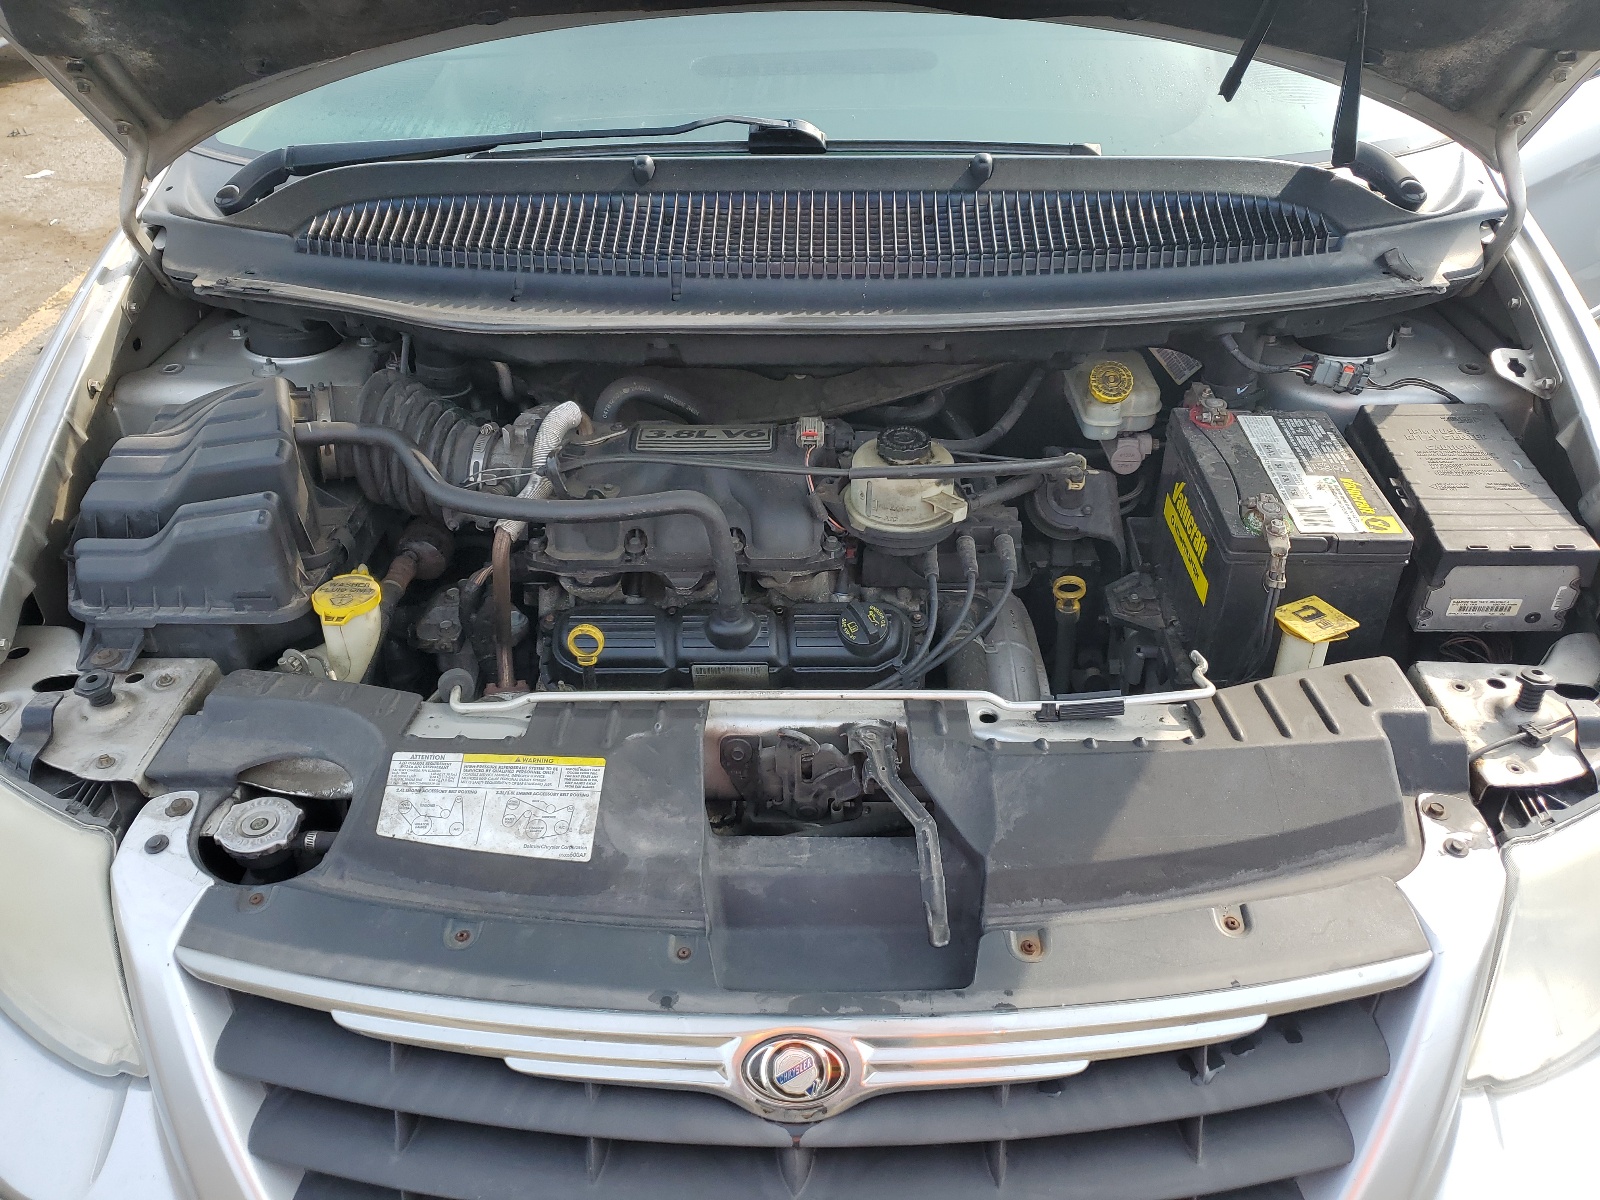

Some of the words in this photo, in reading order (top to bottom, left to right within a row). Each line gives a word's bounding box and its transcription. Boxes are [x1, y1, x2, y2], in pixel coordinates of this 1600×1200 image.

[645, 429, 717, 439] 3.8L
[722, 429, 766, 439] V6
[1172, 482, 1208, 567] Valucraft
[779, 1057, 813, 1085] CHRYSLER
